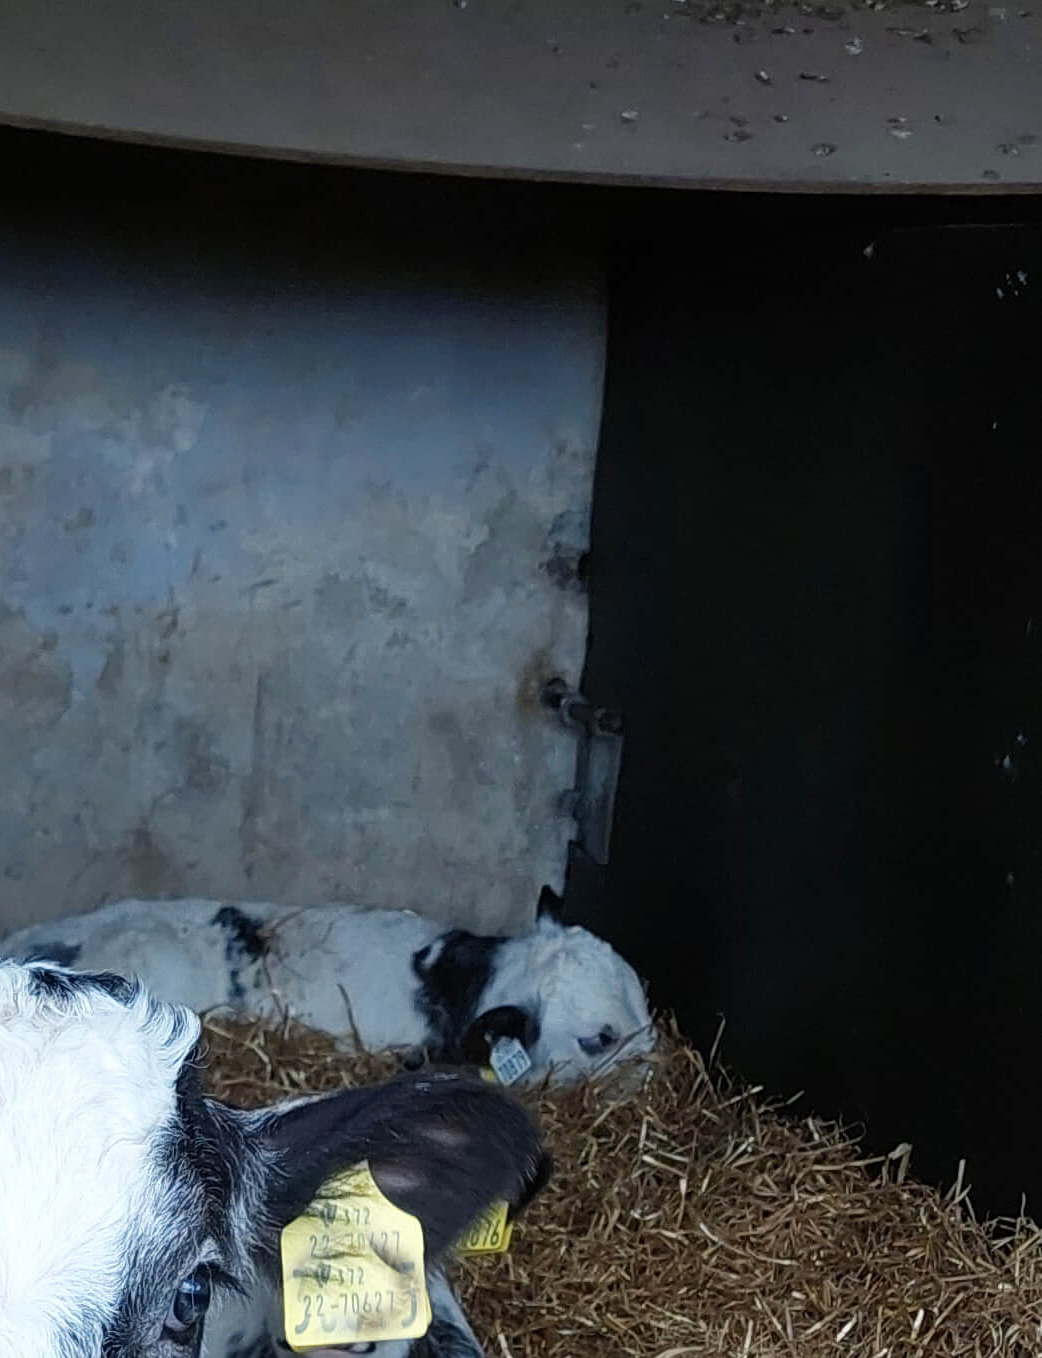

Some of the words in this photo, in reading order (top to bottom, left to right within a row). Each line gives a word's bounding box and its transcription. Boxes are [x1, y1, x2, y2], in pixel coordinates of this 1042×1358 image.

[344, 1207, 371, 1225] 372
[310, 1231, 401, 1257] 2270627
[338, 1266, 364, 1286] 372
[303, 1291, 394, 1318] 22-70627
